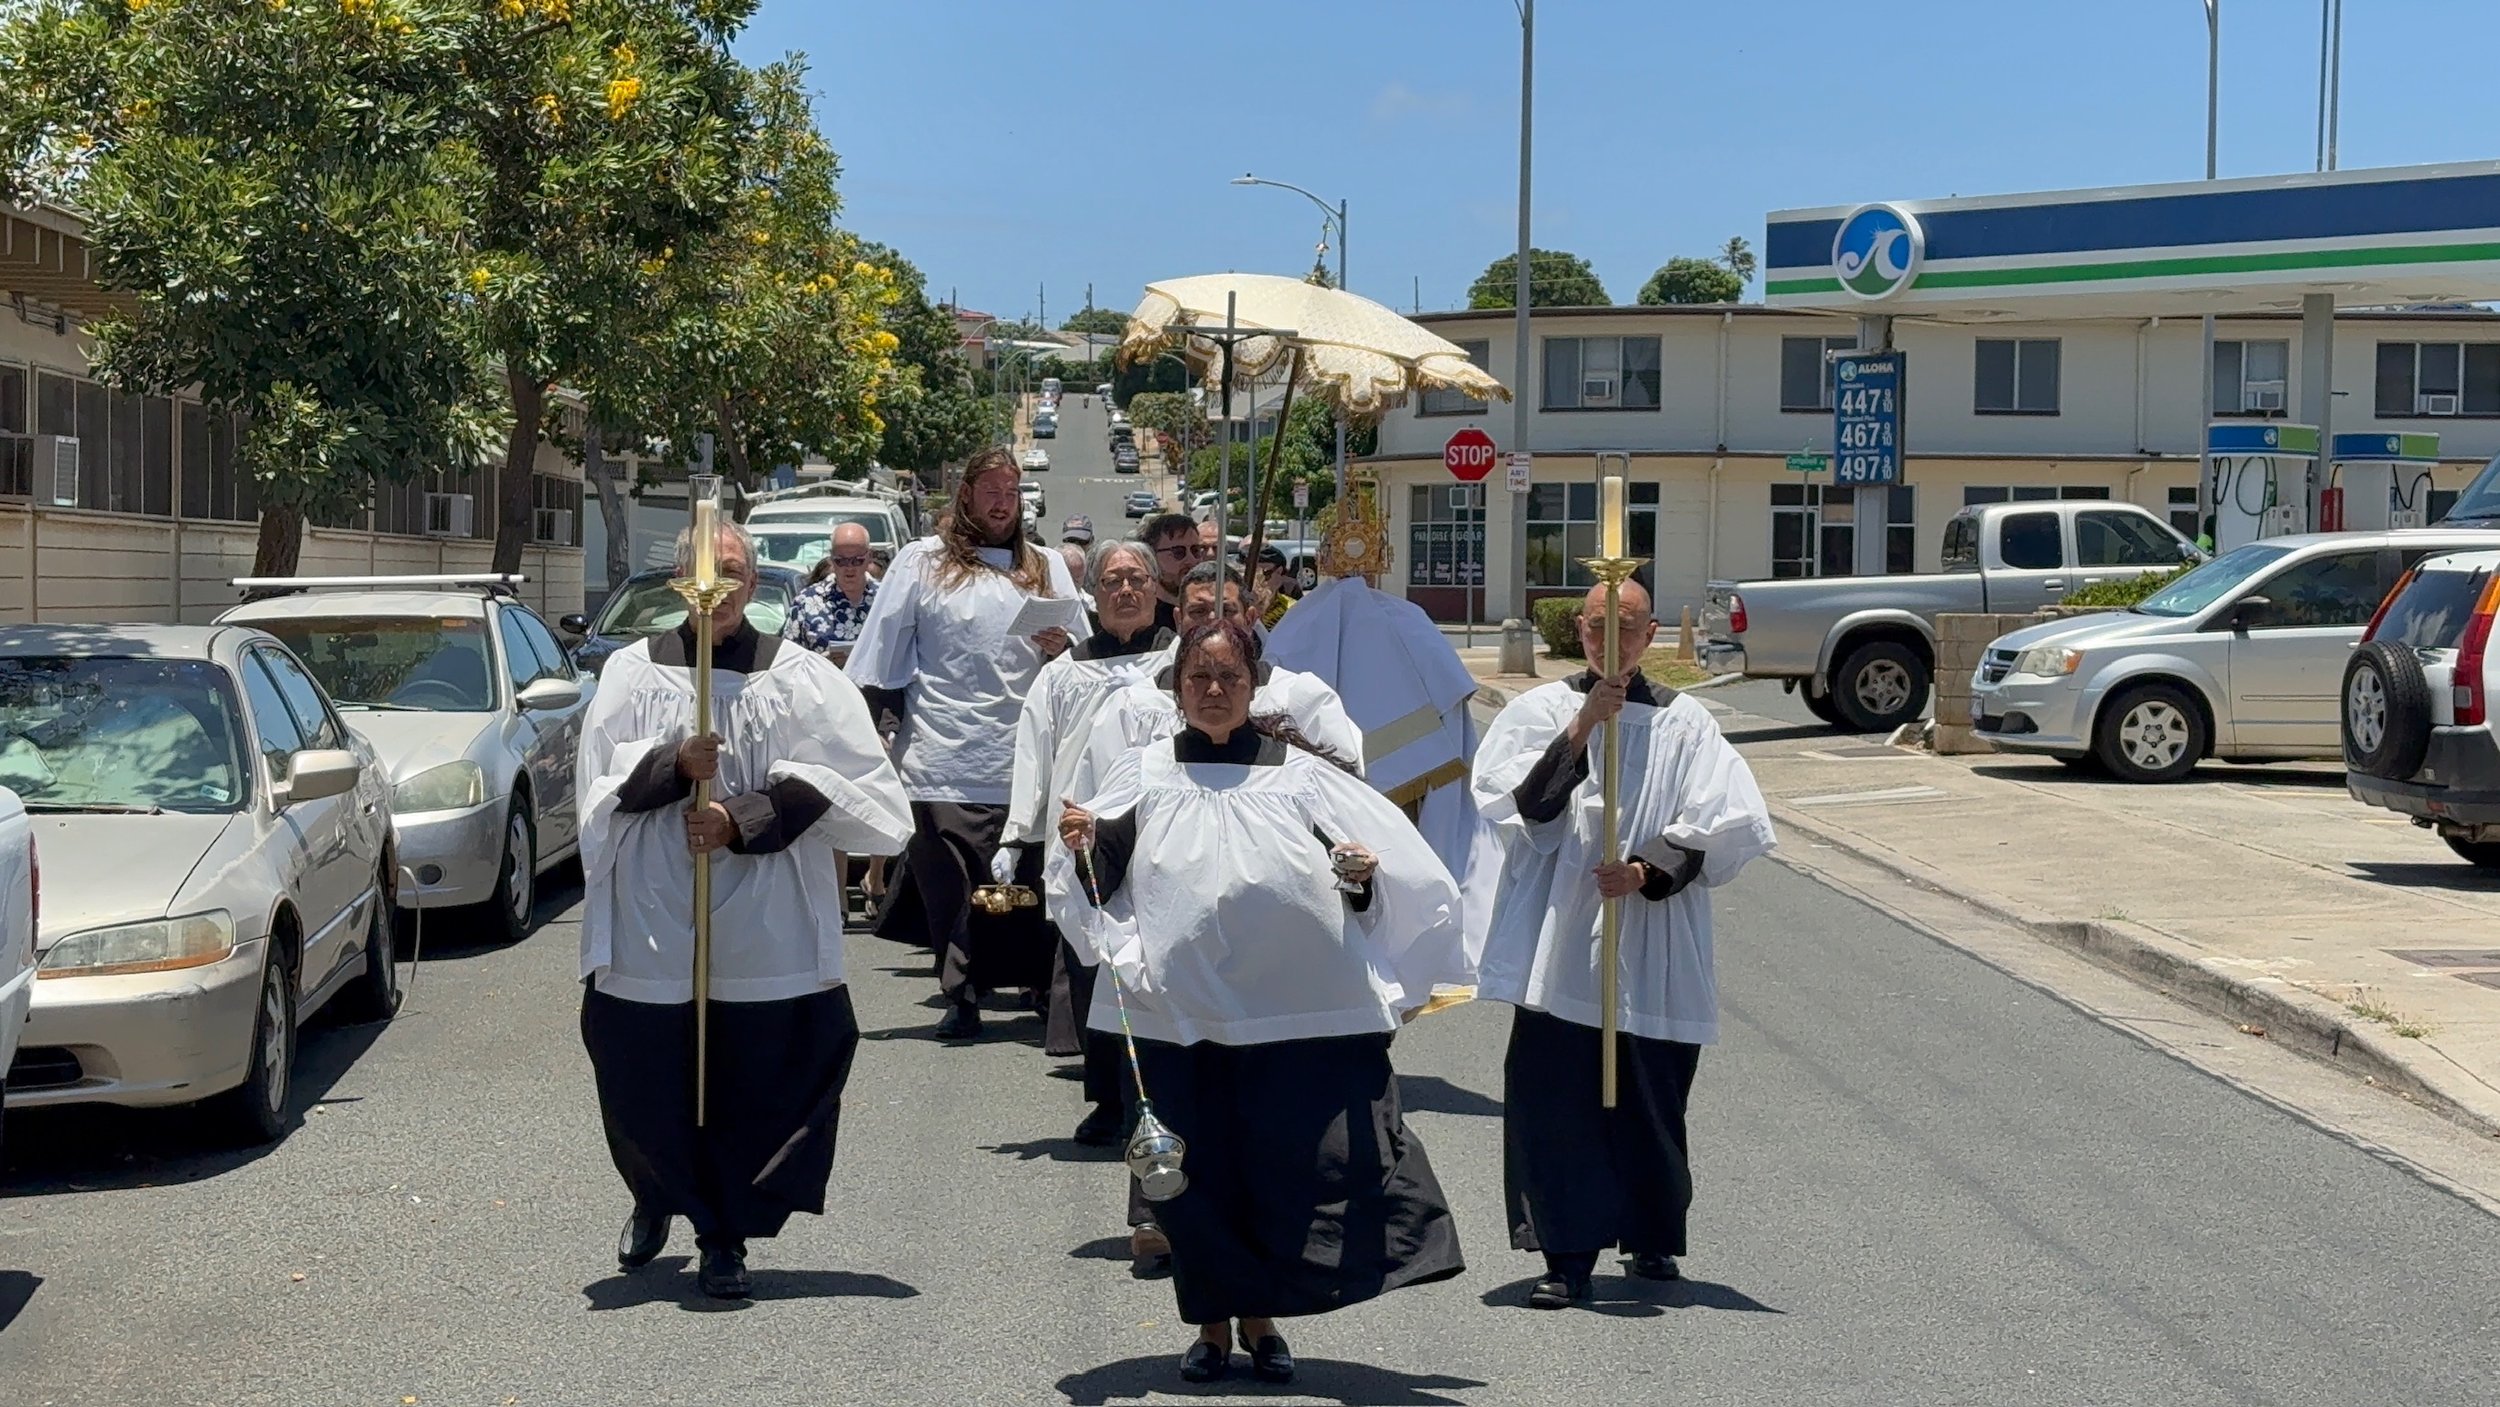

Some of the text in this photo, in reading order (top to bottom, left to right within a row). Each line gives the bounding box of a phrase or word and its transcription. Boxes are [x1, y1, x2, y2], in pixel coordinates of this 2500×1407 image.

[1858, 362, 1895, 374] ALOHA
[1841, 388, 1892, 415] 447 9
[1882, 400, 1893, 413] 10
[1840, 421, 1891, 448] 467 9
[1882, 434, 1892, 447] 10
[1448, 445, 1493, 466] STOP
[1510, 469, 1526, 477] ANY
[1840, 455, 1891, 481] 497 9
[1881, 467, 1892, 480] 10
[1509, 479, 1527, 487] TIME
[1414, 531, 1448, 541] PARDISE
